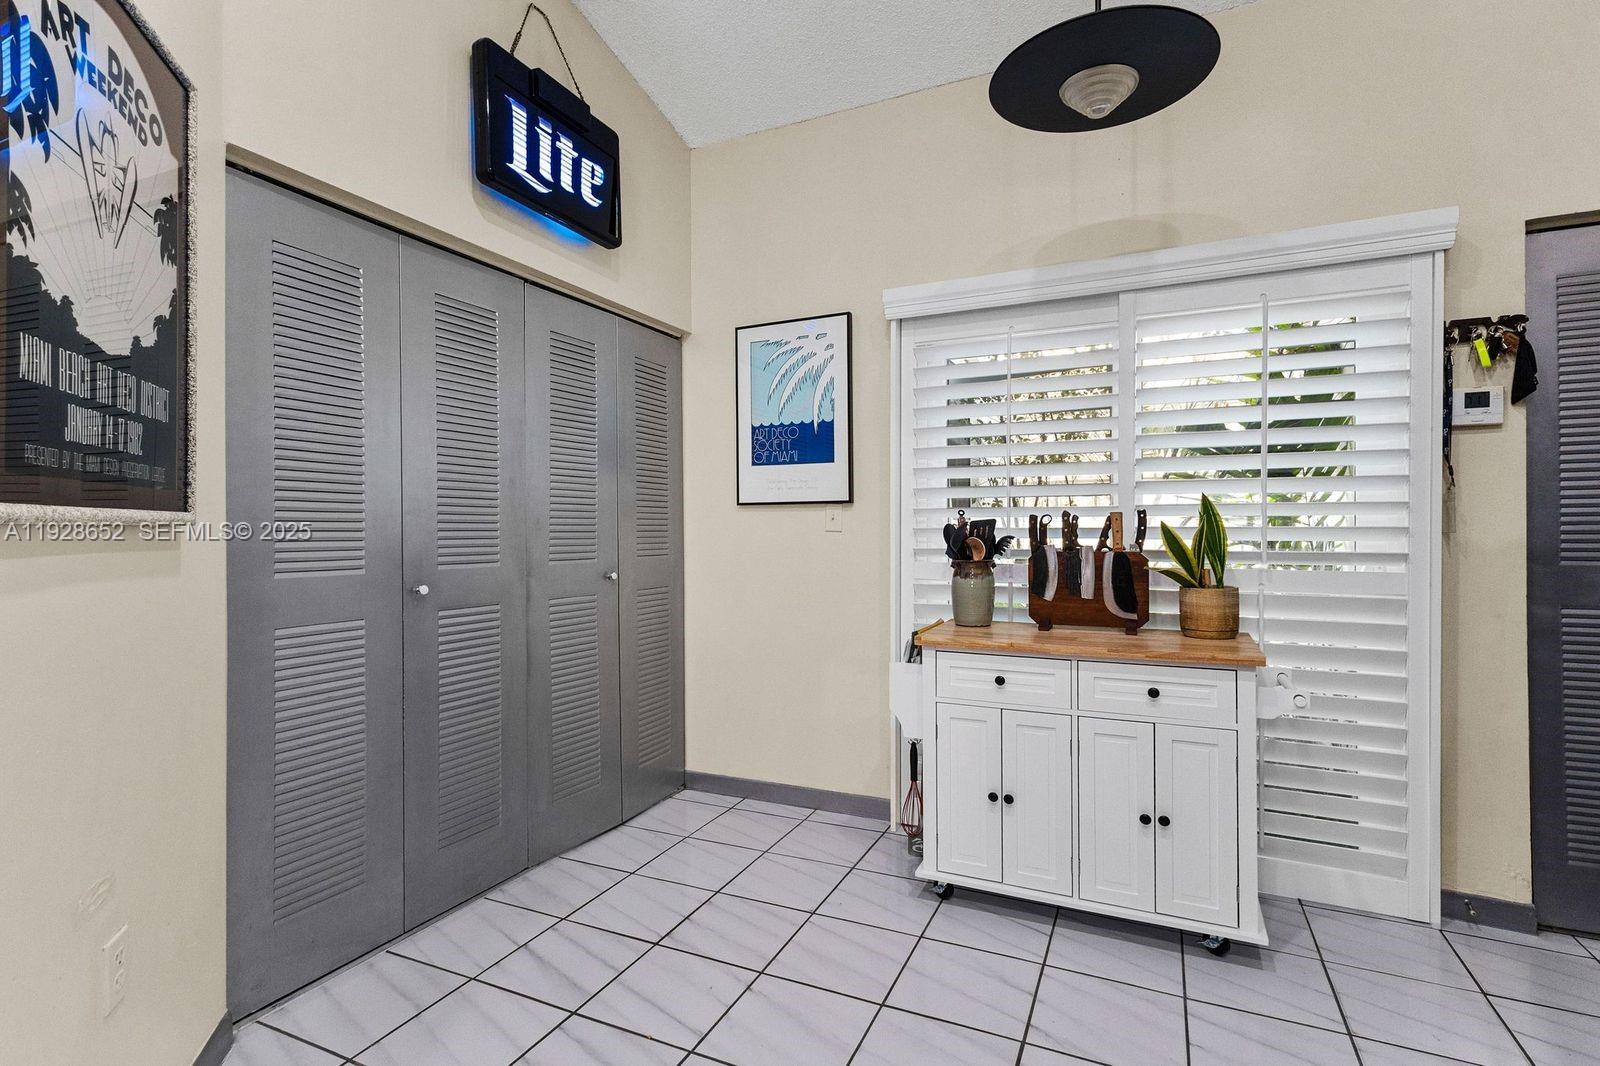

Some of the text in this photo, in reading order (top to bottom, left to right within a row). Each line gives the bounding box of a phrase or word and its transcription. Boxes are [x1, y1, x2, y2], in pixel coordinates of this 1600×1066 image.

[41, 0, 163, 147] ART DECO
[65, 44, 148, 147] WEEKEND
[504, 94, 605, 208] Lite
[19, 331, 171, 423] MIAMI BEACH ART DECO DISTRICT
[64, 403, 103, 448] JANUARY
[754, 426, 799, 440] ART DECO
[754, 439, 792, 451] SOCIETY
[24, 443, 60, 469] PRESENTED
[754, 450, 798, 463] OF MIAMI
